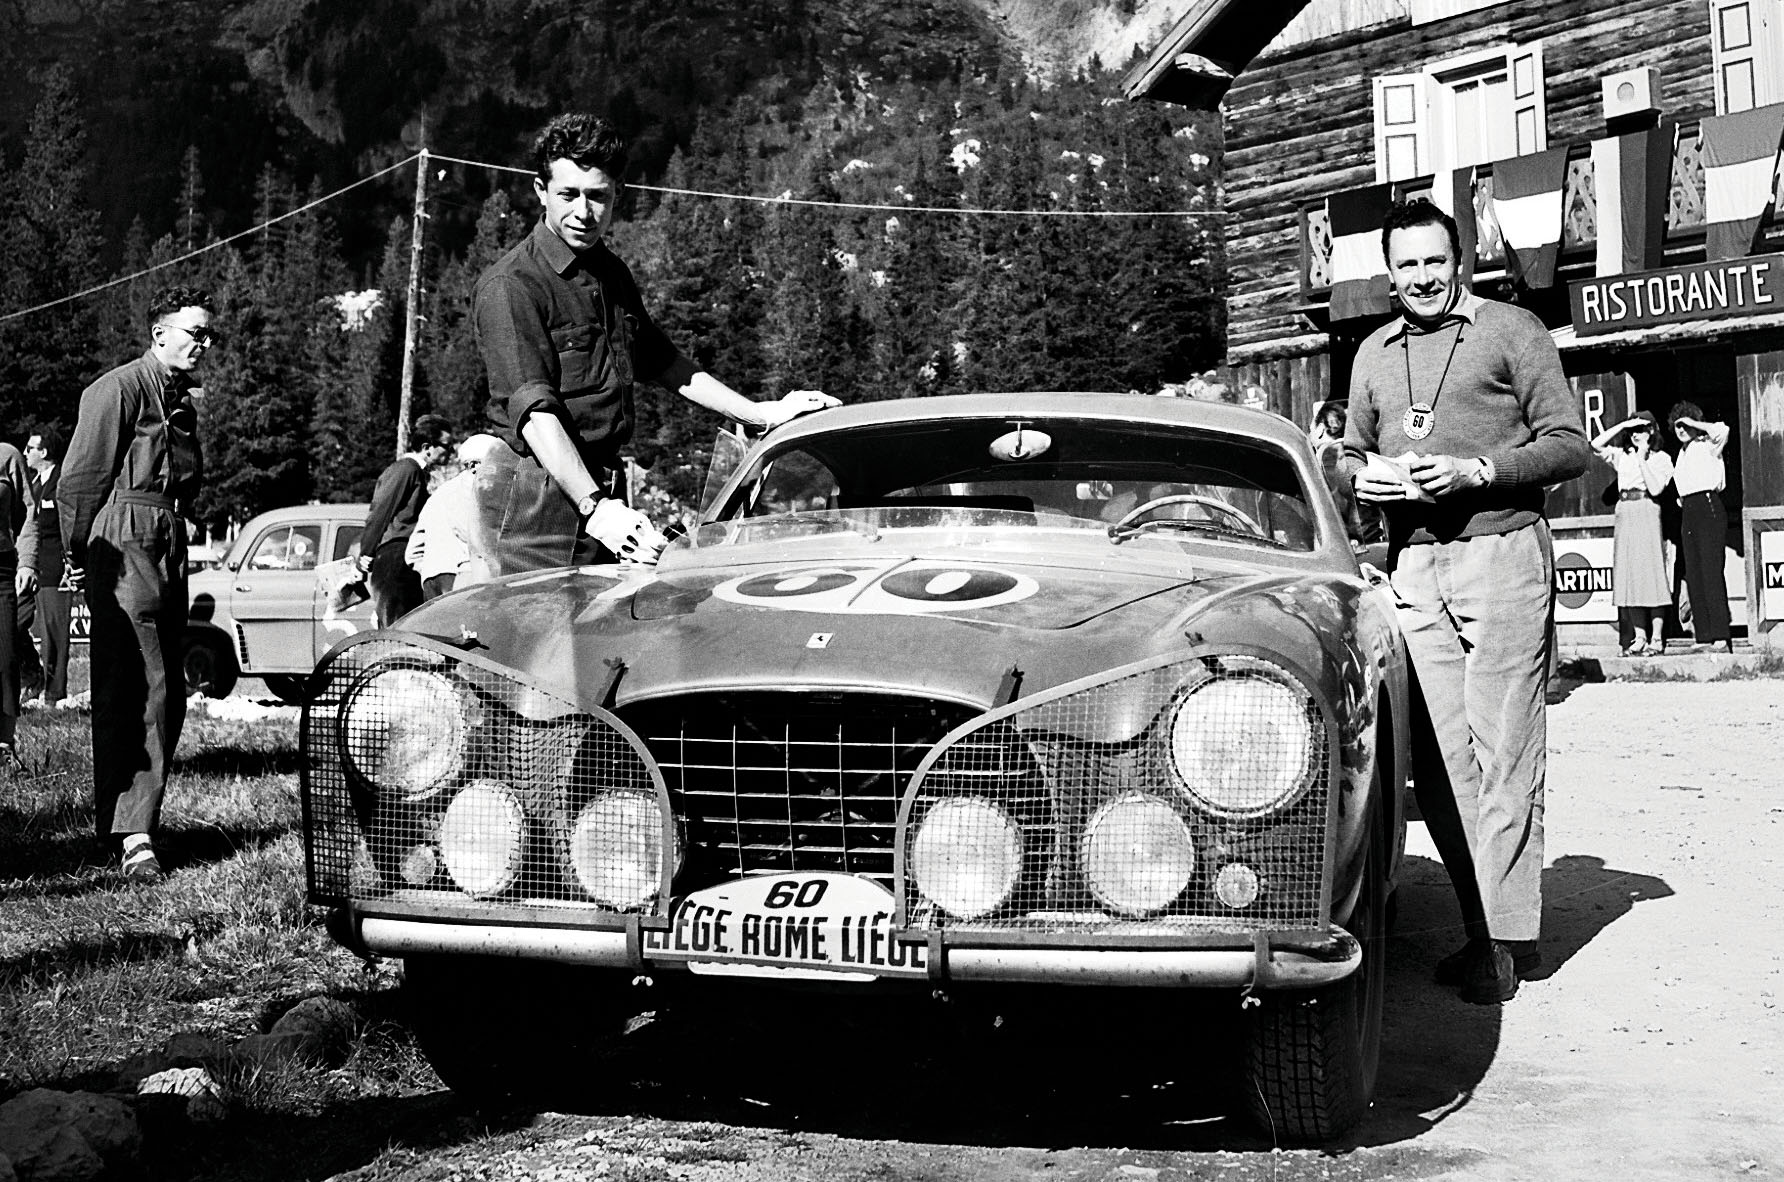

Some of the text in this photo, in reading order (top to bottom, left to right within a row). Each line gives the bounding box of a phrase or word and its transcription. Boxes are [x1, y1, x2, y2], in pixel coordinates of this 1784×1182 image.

[1582, 263, 1772, 323] RISTORANTE
[1412, 414, 1425, 428] 60
[736, 566, 1019, 601] 60
[764, 880, 828, 909] 60
[742, 914, 828, 960] ROME
